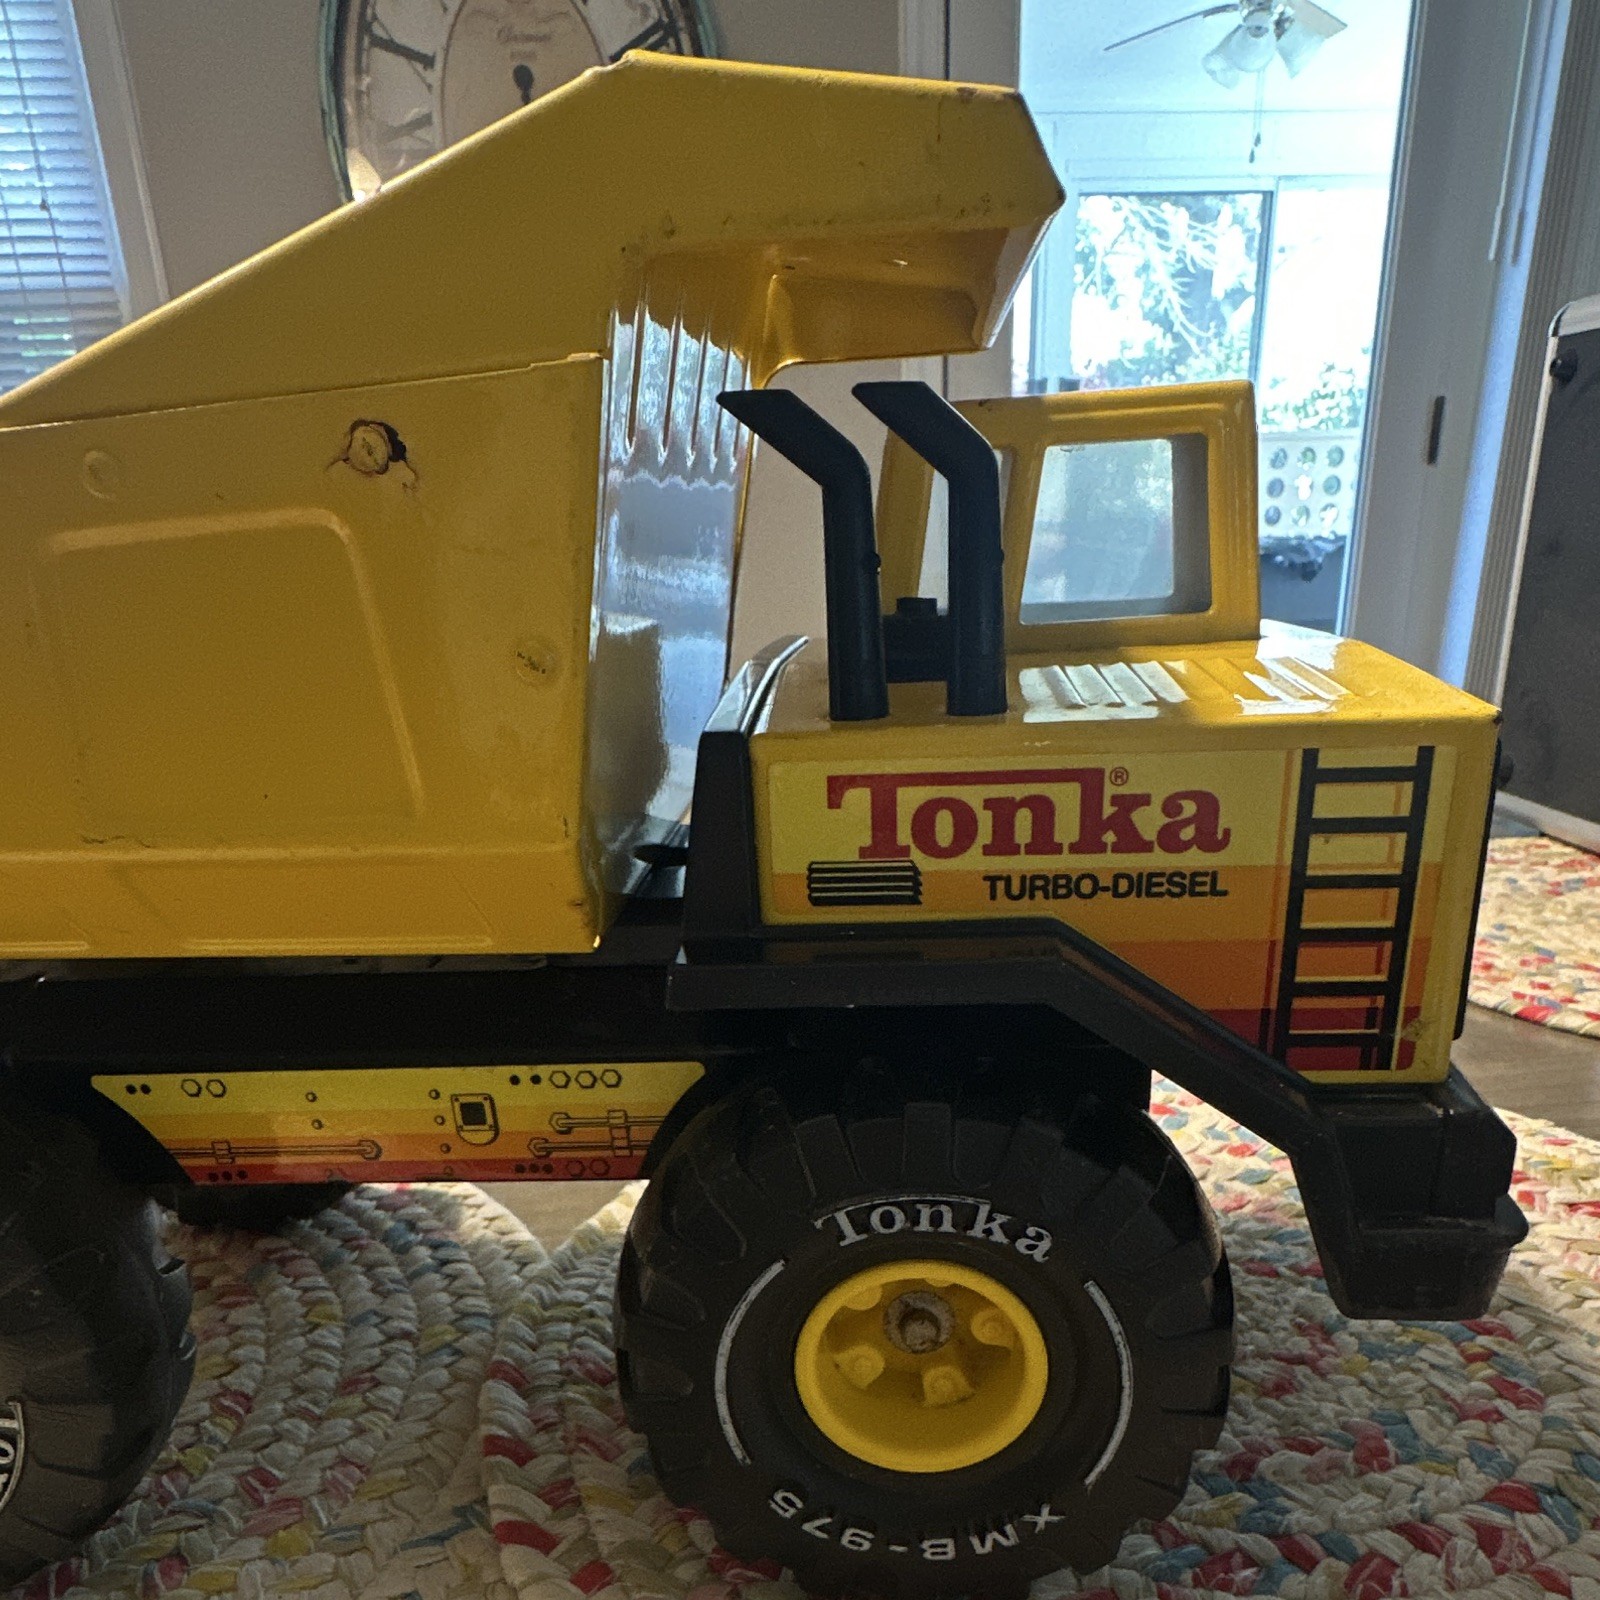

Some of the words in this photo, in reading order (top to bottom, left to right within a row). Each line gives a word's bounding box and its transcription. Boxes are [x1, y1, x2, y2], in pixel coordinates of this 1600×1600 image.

[982, 870, 1229, 901] TURBO-DIESEL
[810, 1194, 1053, 1263] Tonka
[769, 1488, 1066, 1561] XMB-975
